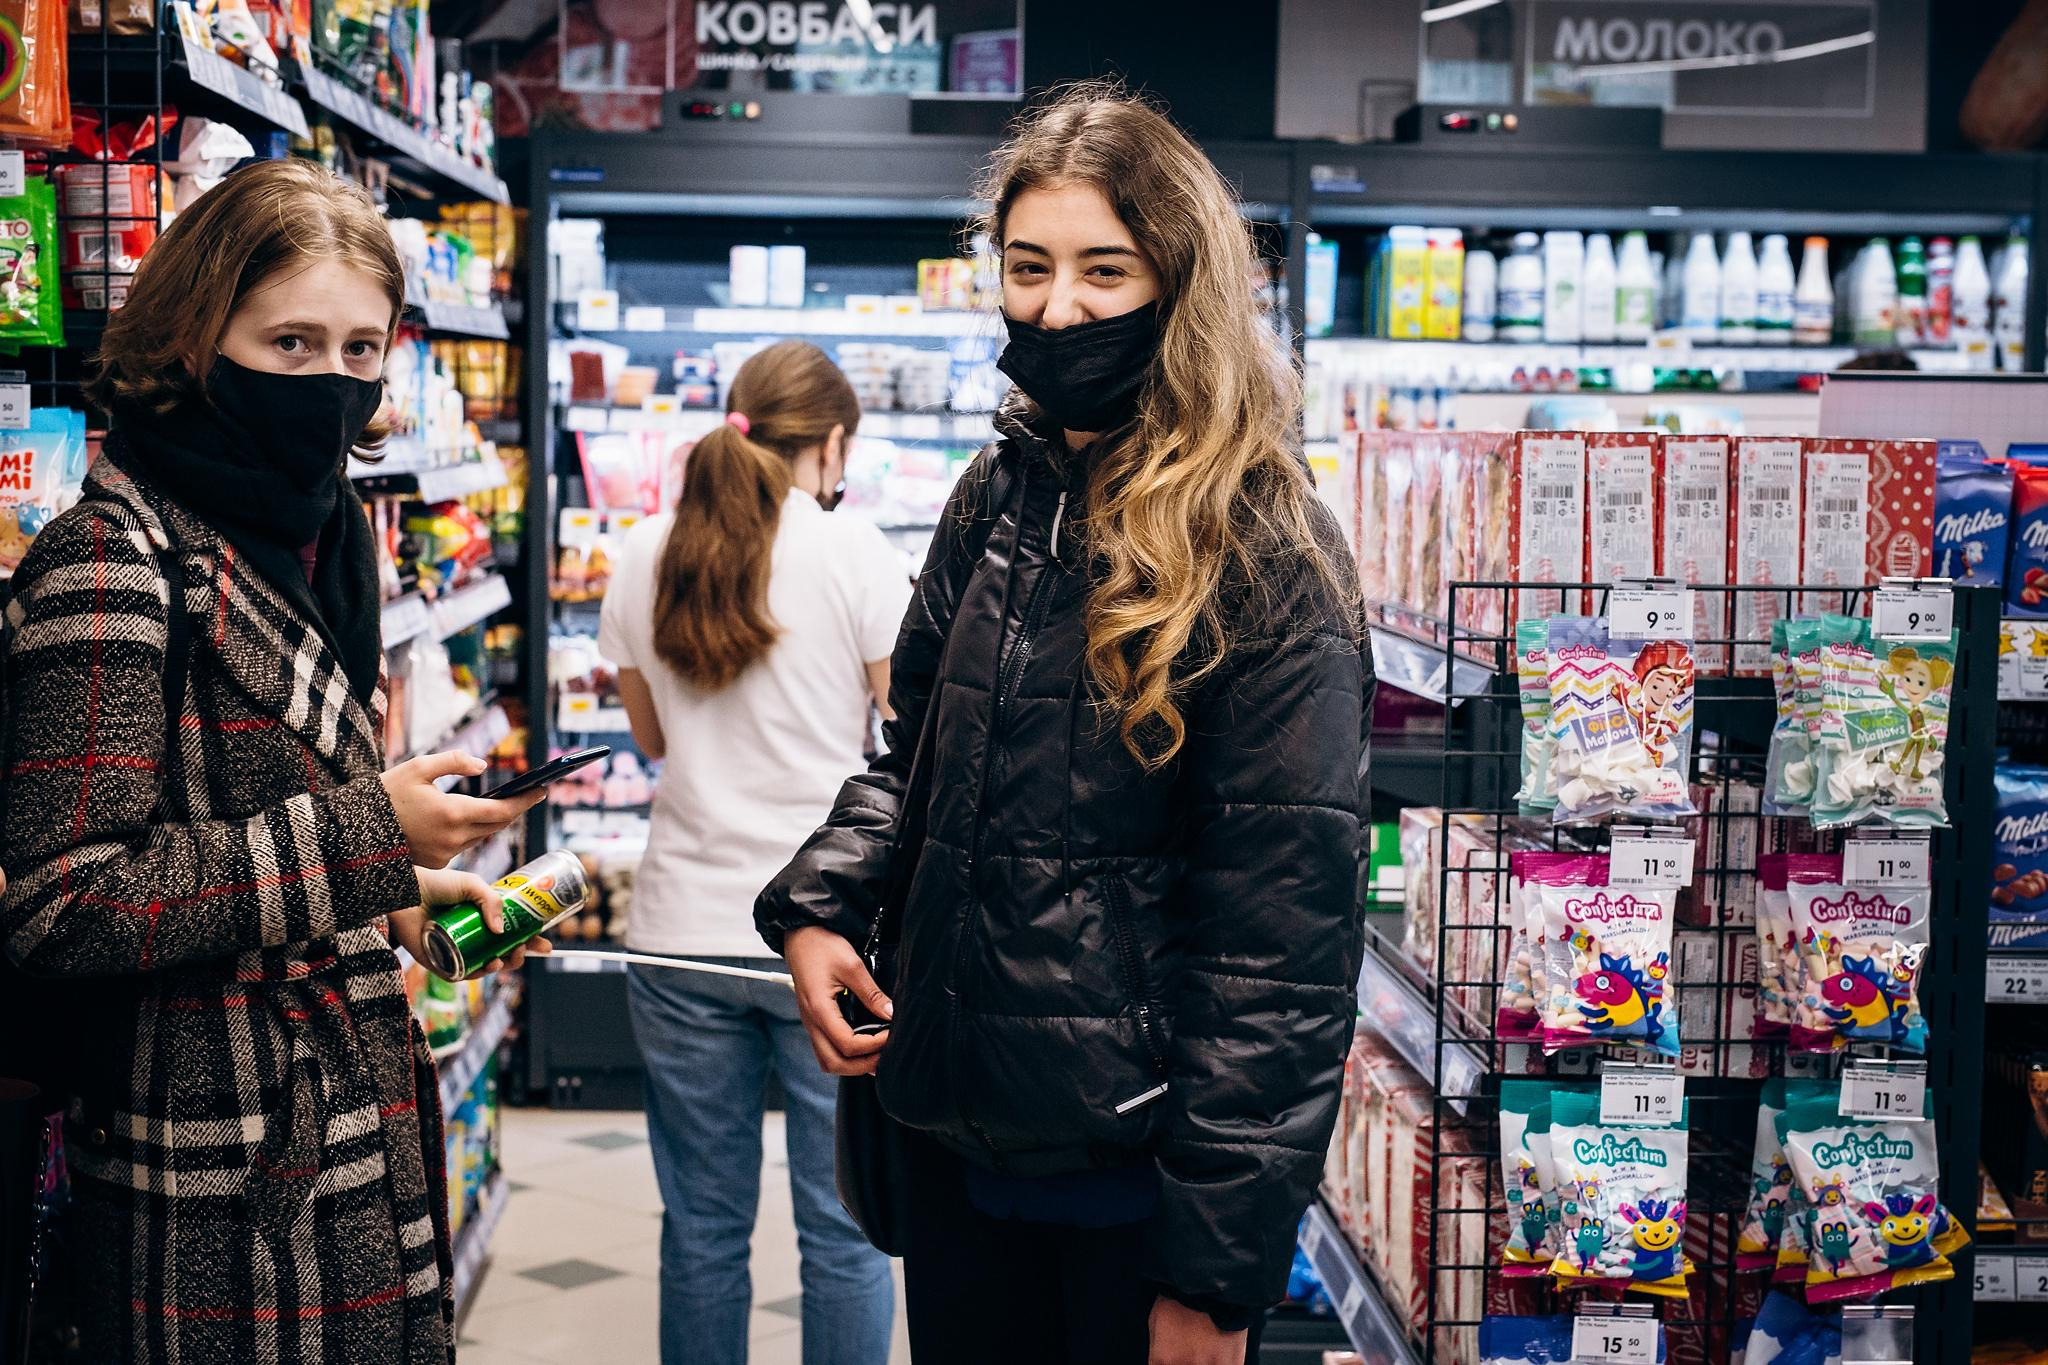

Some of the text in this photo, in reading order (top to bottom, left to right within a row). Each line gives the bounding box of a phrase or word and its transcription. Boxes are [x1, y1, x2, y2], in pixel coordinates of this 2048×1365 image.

[696, 3, 937, 46] КОВБАСИ
[1554, 17, 1785, 62] МОЛОКО
[1934, 507, 2007, 544] Milka
[1647, 611, 1675, 629] 9 00
[1908, 612, 1936, 630] 9 00
[1857, 725, 1906, 744] Mallows
[1643, 858, 1676, 876] 11 00
[1878, 860, 1911, 877] 11 00
[1566, 893, 1661, 922] Confectum
[1811, 892, 1910, 924] Confectum
[2004, 977, 2028, 994] 22
[1635, 1095, 1667, 1112] 11 00
[1875, 1091, 1907, 1109] 11 00
[1575, 1134, 1666, 1166] Confectum
[1813, 1133, 1912, 1168] Confectum
[1602, 1336, 1640, 1354] 15 50
